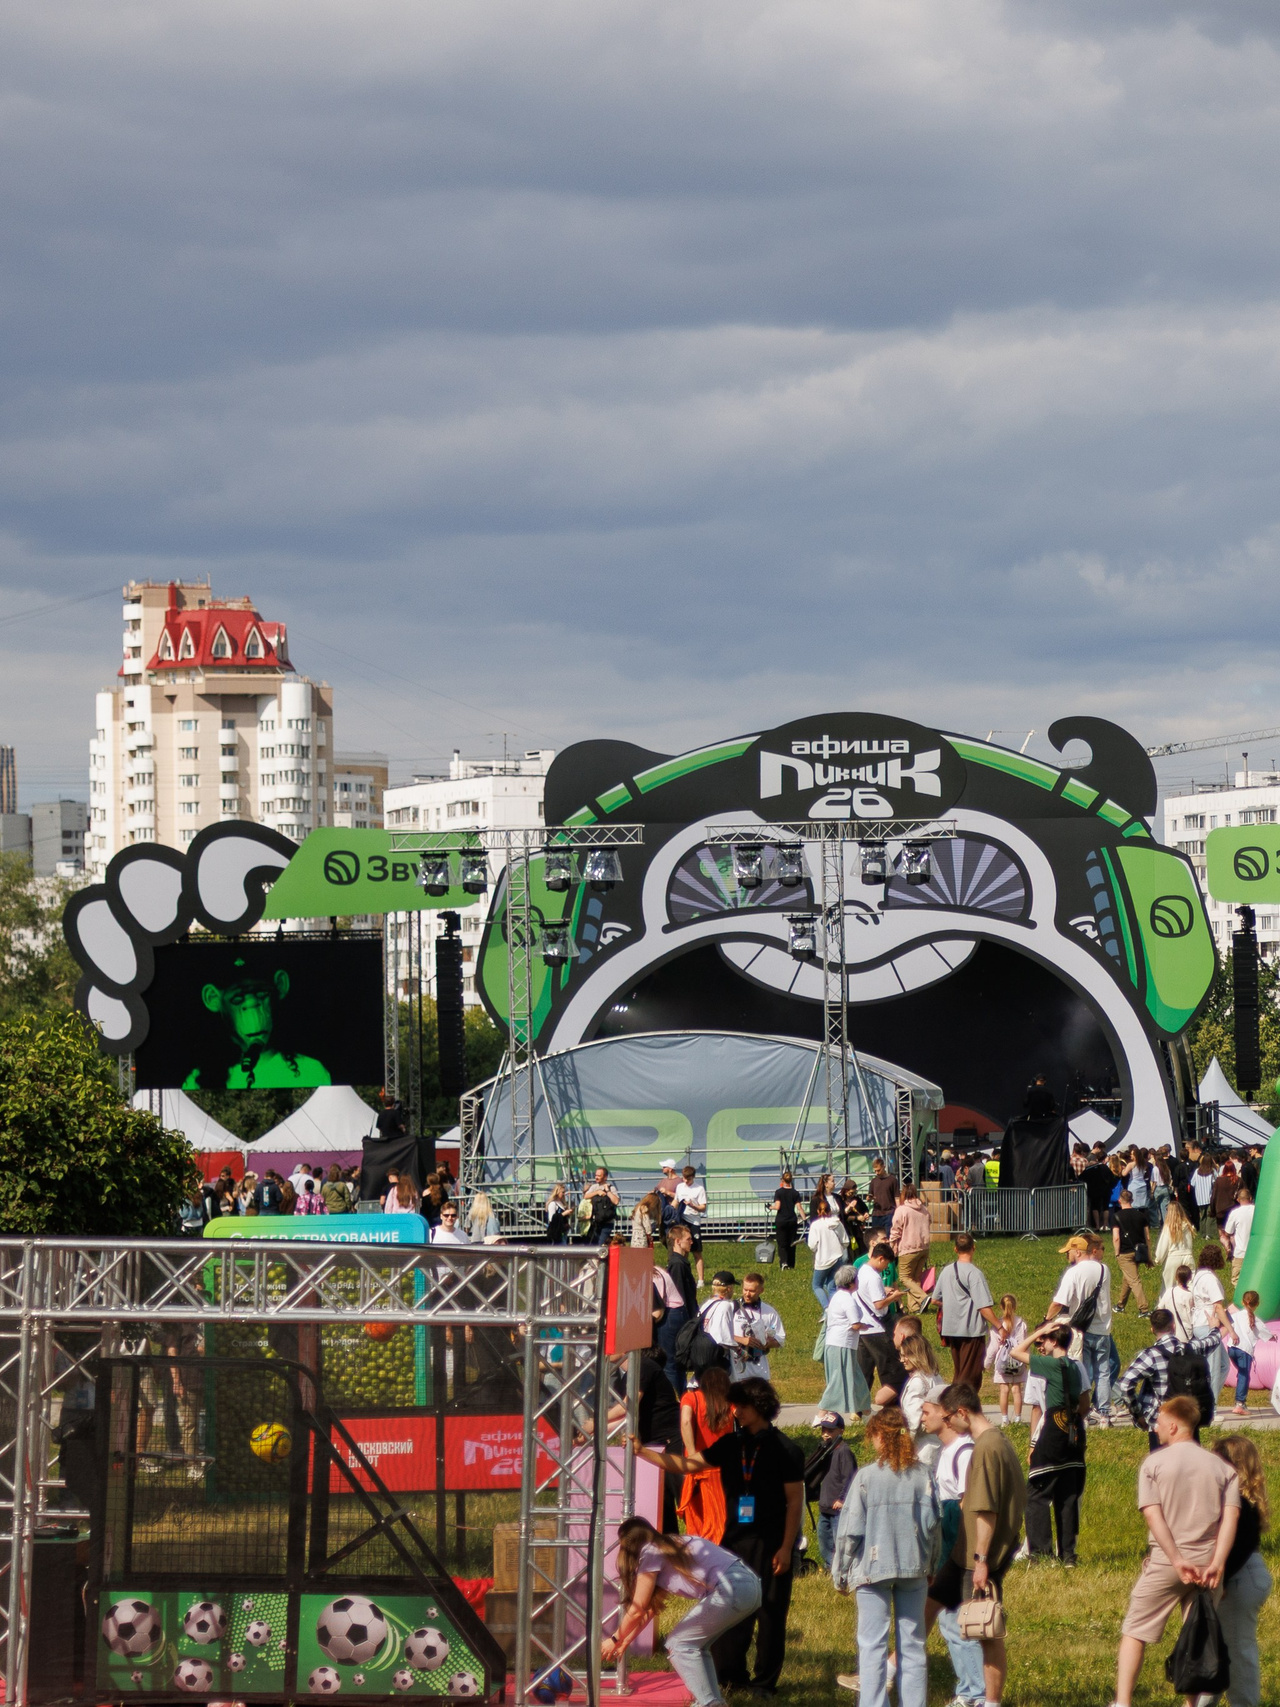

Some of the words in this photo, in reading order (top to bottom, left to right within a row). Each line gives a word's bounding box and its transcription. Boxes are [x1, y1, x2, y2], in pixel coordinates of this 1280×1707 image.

[791, 735, 910, 759] афиша
[808, 788, 894, 818] 26
[367, 855, 420, 882] Зв
[292, 1231, 400, 1243] СТРАХОВАНИЕ
[480, 1430, 544, 1443] афиа
[349, 1455, 379, 1468] СПРТ
